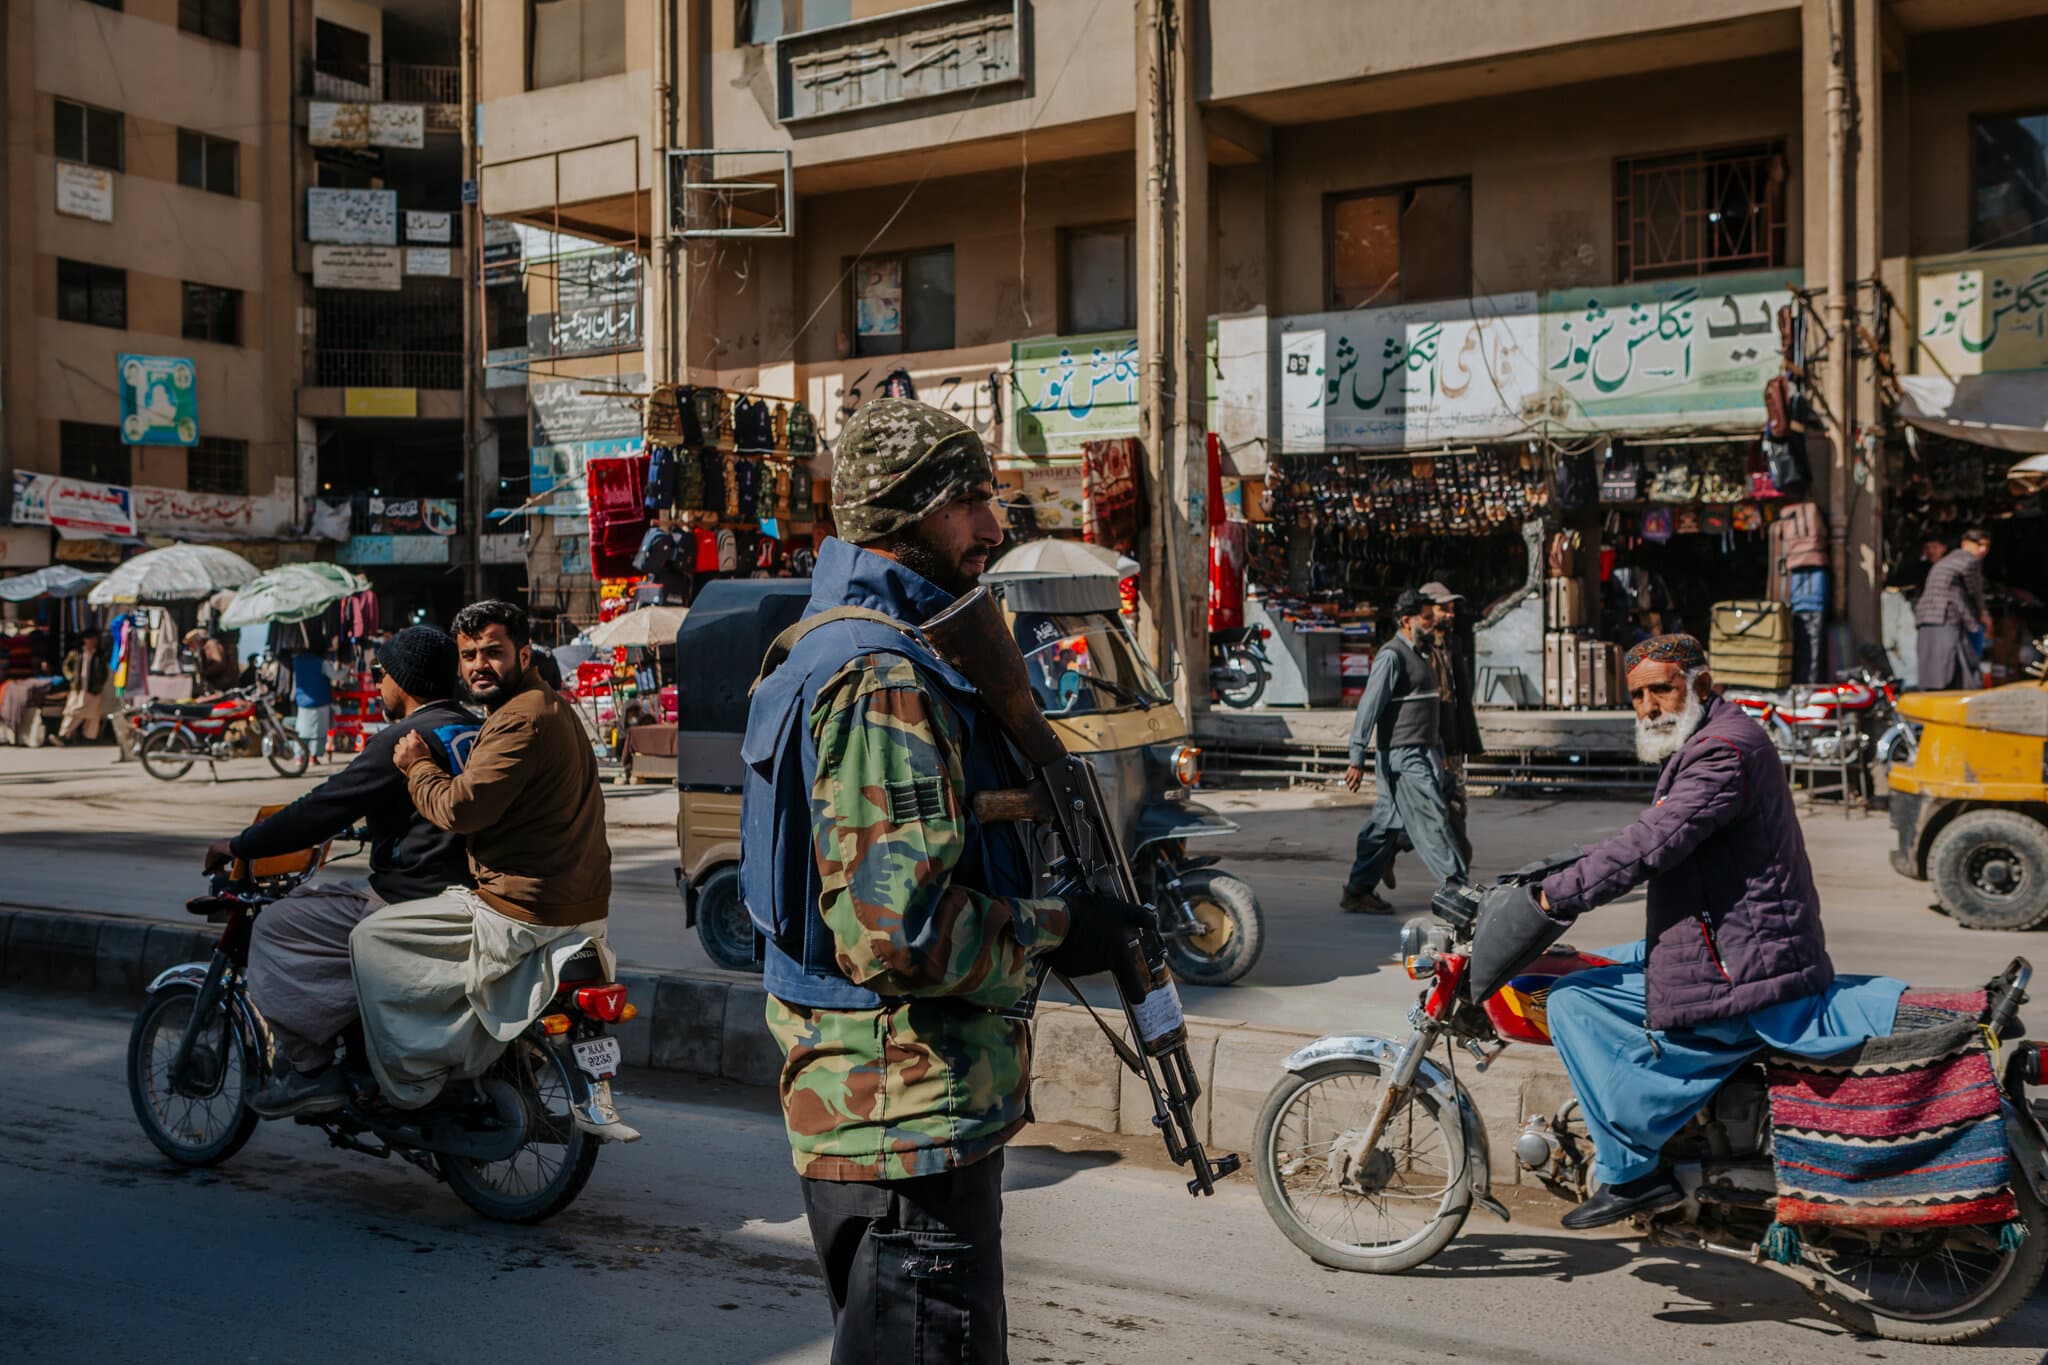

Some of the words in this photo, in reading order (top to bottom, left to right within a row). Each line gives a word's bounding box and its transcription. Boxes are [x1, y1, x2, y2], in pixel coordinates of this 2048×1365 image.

[1549, 298, 1615, 382] شوز
[1592, 287, 1699, 394] انگلش
[1920, 273, 1979, 337] شوز
[1026, 348, 1076, 412] شوز
[1306, 336, 1359, 409] شوز
[1352, 321, 1445, 411] انگلش
[588, 1053, 612, 1067] 9235
